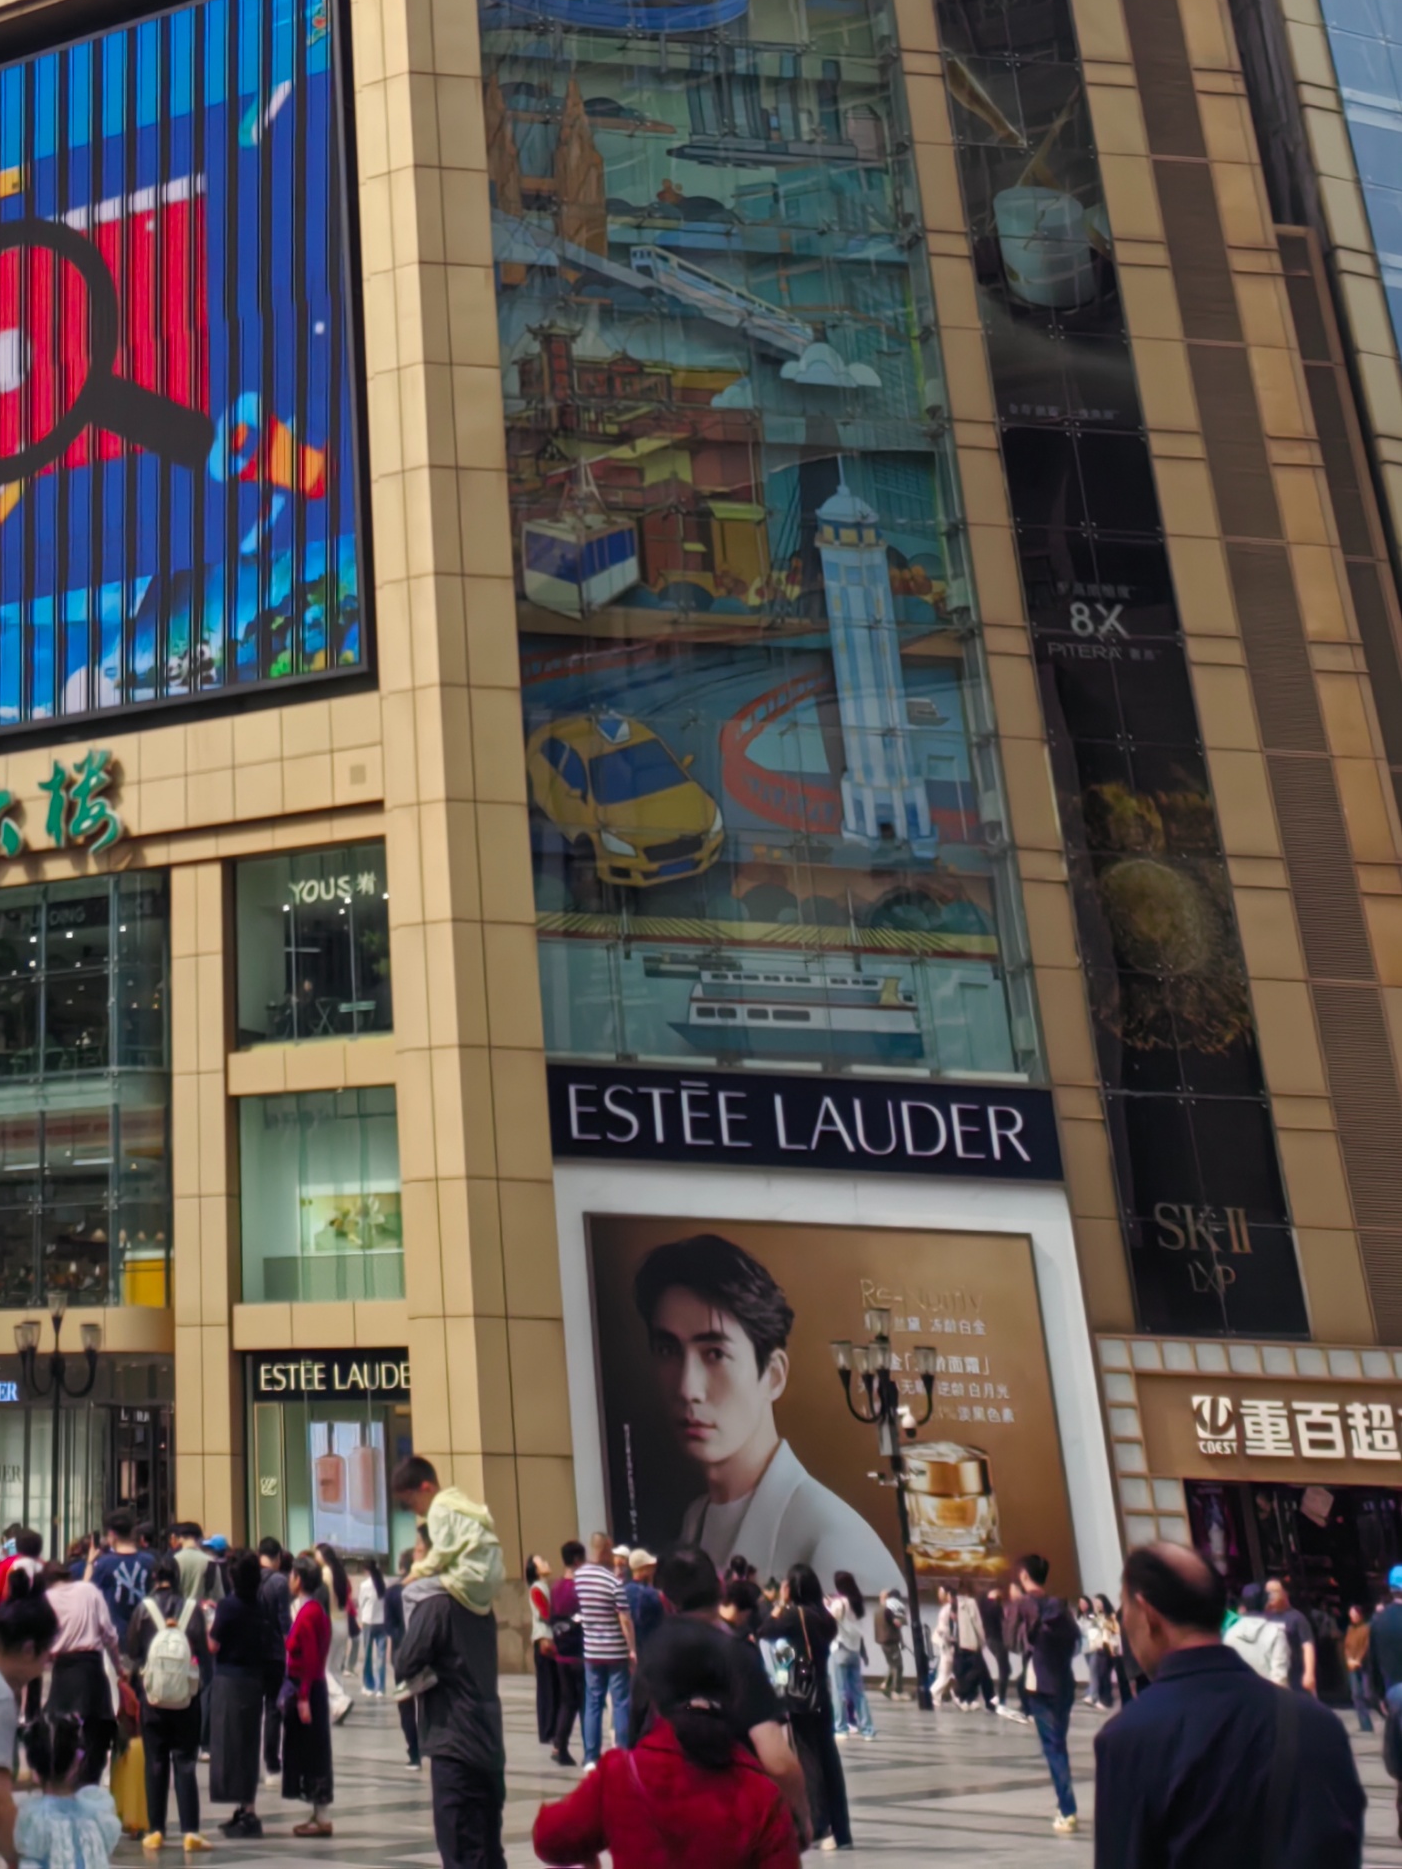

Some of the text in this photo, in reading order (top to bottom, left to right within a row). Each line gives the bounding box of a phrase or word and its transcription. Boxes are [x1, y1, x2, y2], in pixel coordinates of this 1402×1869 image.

[1070, 601, 1131, 639] 8X
[774, 1092, 1032, 1163] LAUDER
[1240, 1399, 1402, 1461] 重百超
